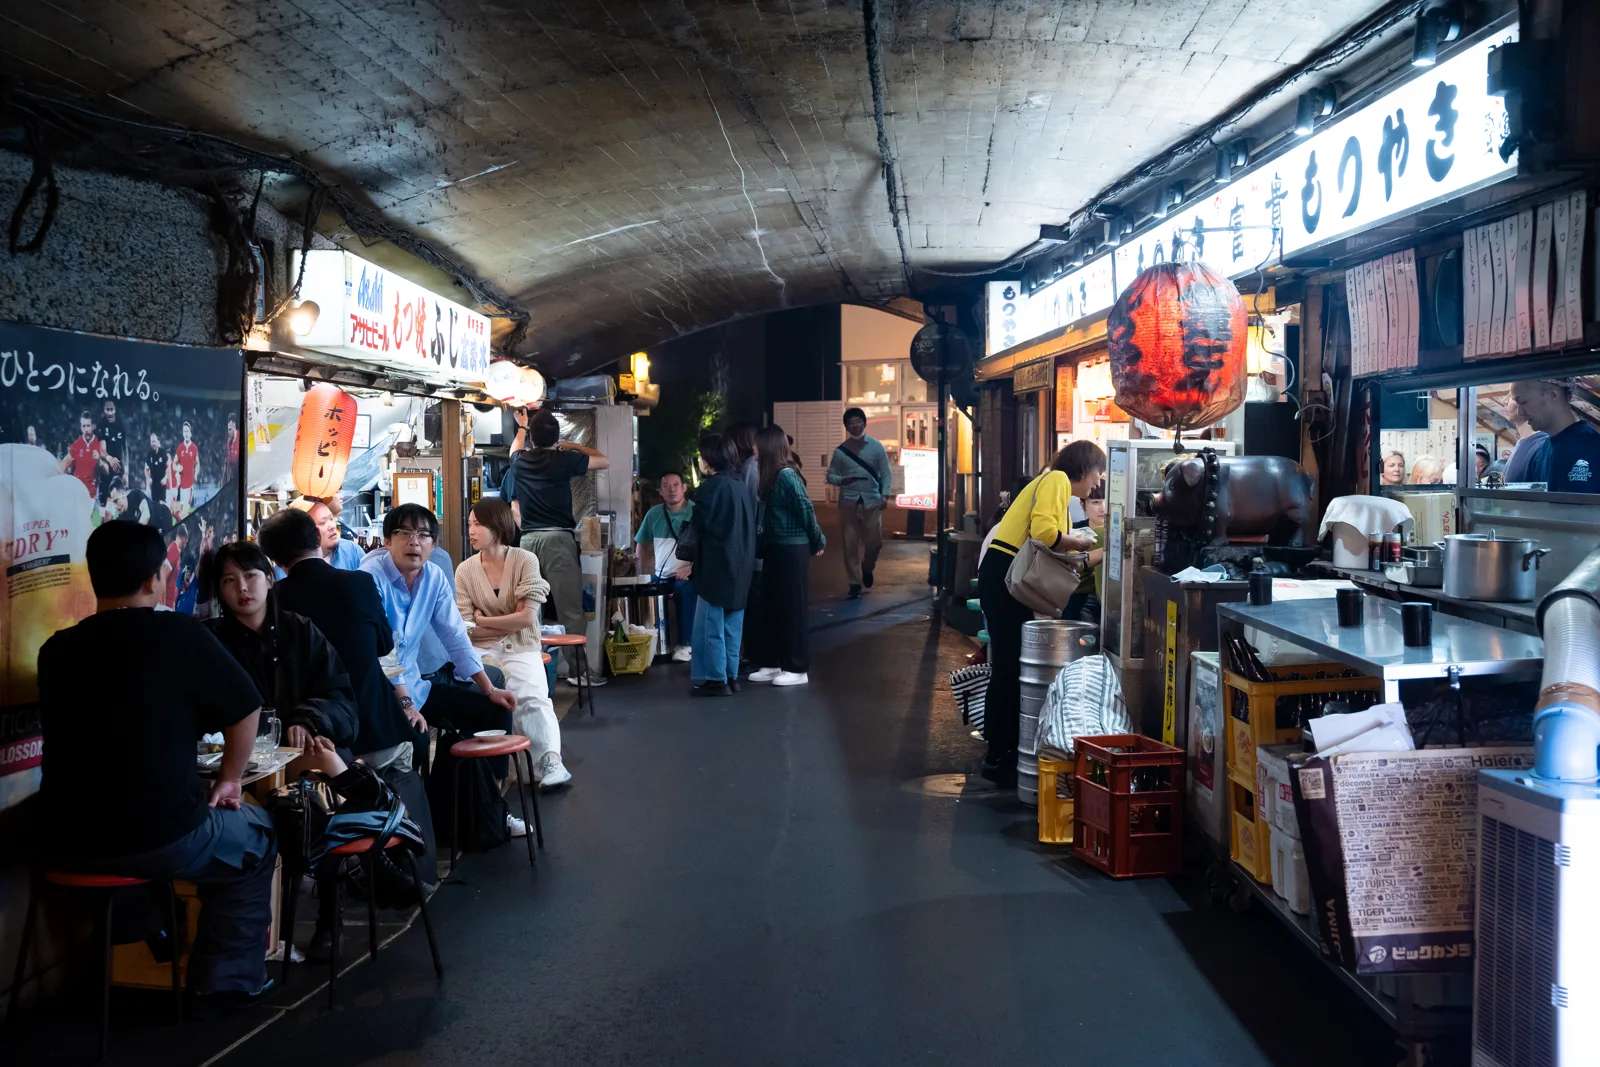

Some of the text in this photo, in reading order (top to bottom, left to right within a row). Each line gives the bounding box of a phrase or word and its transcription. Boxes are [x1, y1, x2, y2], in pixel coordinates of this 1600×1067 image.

[1230, 171, 1288, 263] 富貴
[1301, 80, 1458, 234] もつやき
[1508, 223, 1516, 261] タン
[1521, 219, 1528, 251] レバ
[1540, 211, 1549, 251] ハツ
[1558, 204, 1566, 243] シロ
[1494, 225, 1503, 285] ナンコツ
[357, 264, 384, 315] Asahi
[350, 313, 390, 352] アサヒビール
[393, 290, 427, 359] もつ焼
[430, 300, 459, 369] ふじ
[1002, 285, 1017, 348] もつやき
[0, 350, 160, 402] ひとつになれる。
[317, 403, 344, 478] ホッピー
[23, 519, 50, 532] SUPER
[1471, 755, 1512, 767] Haier
[1392, 852, 1430, 860] CITIZEN
[1365, 879, 1397, 888] FUJITSU
[1385, 893, 1417, 901] DENON
[1357, 908, 1385, 916] TIGER
[1391, 944, 1472, 960] ビックカメラ
